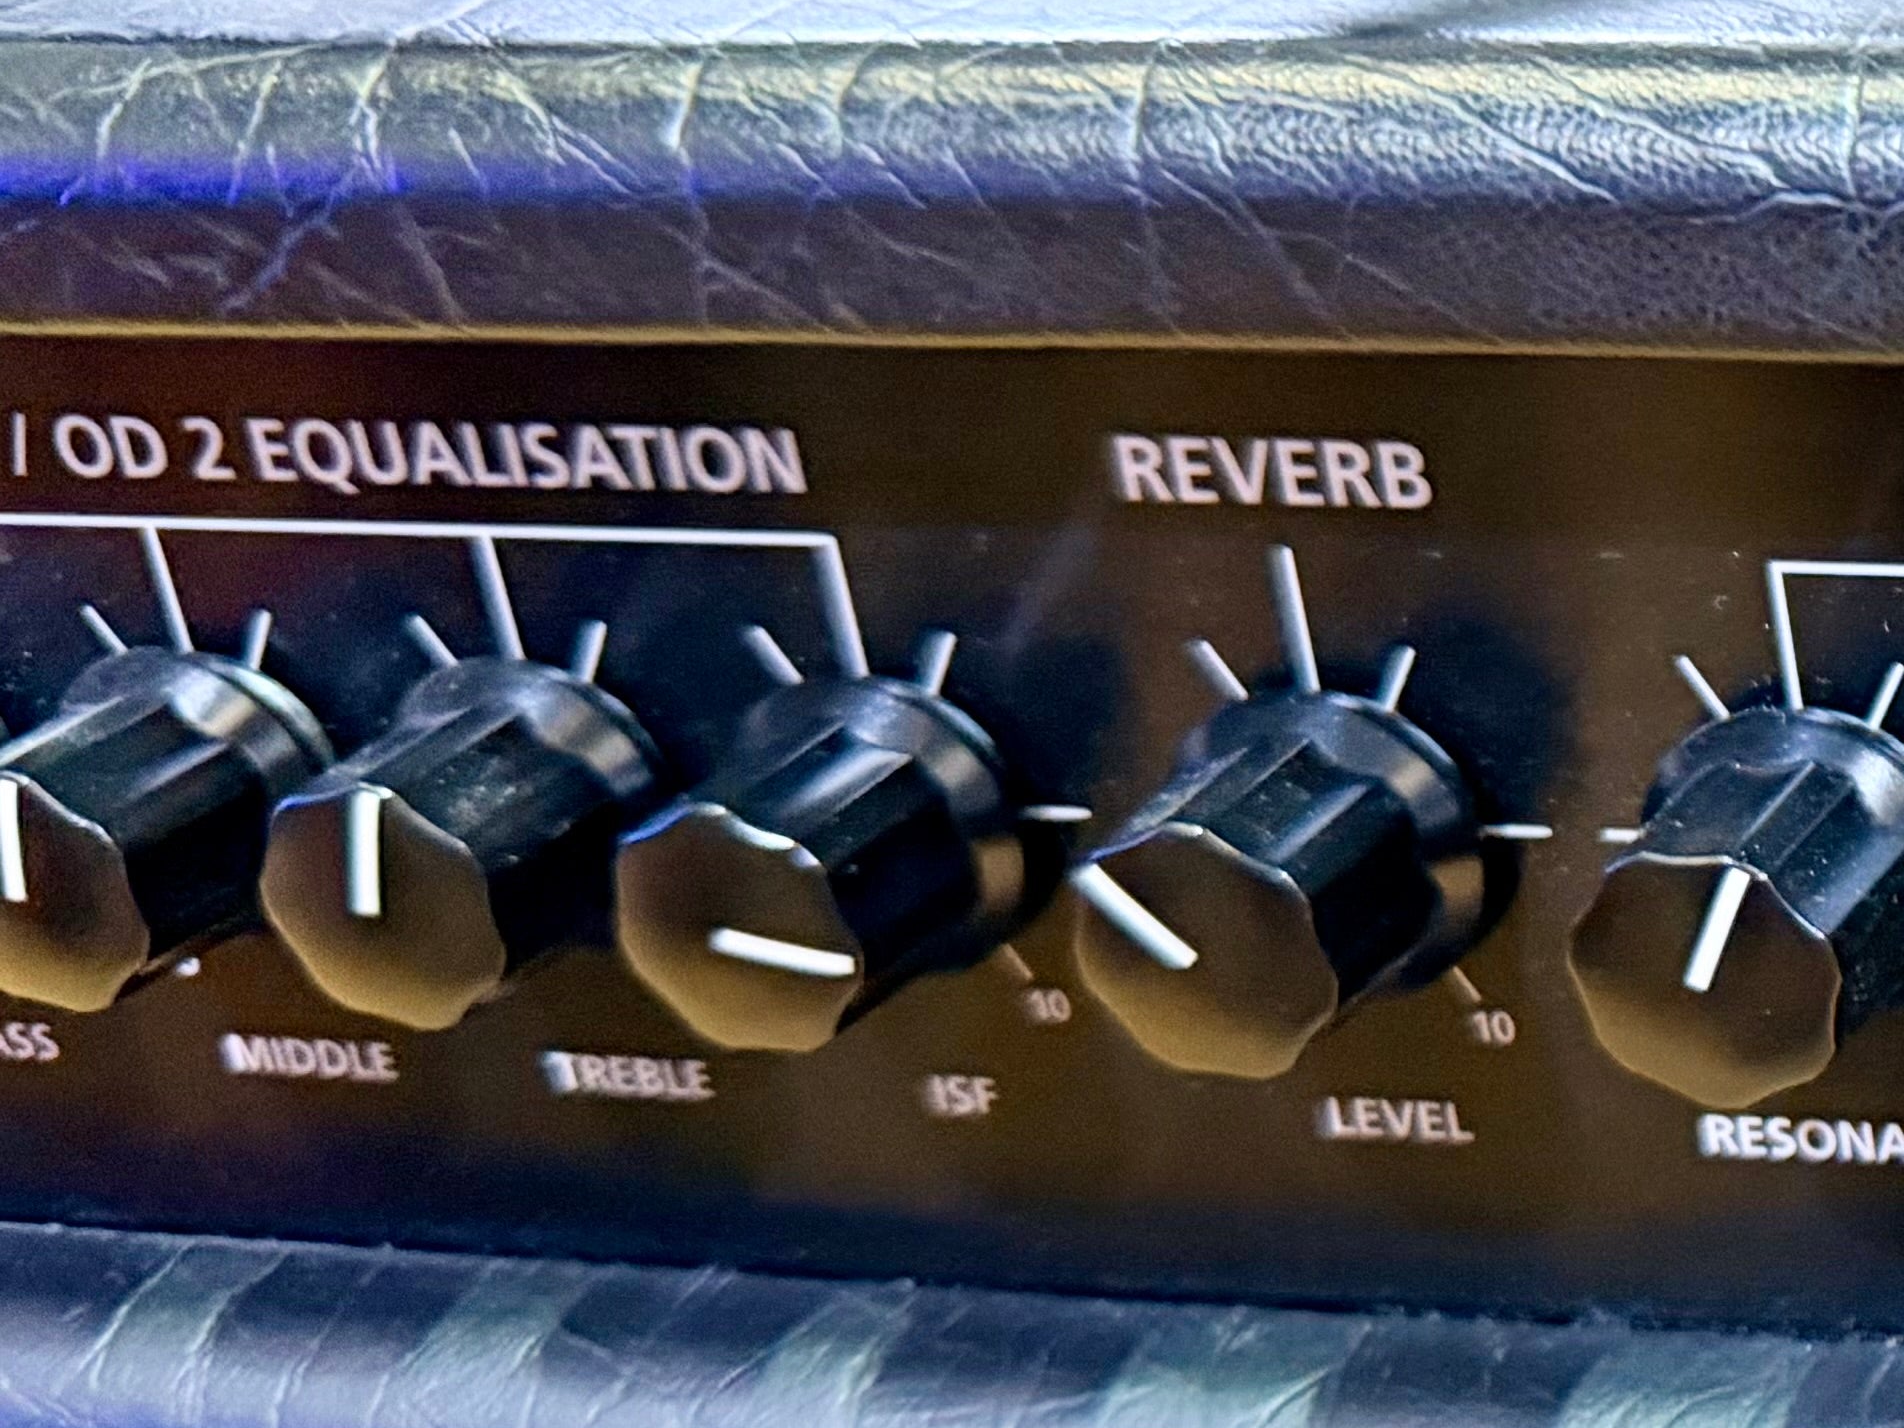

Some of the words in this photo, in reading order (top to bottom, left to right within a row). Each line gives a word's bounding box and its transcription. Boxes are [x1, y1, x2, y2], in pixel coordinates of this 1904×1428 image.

[54, 415, 167, 478] OD
[184, 418, 235, 480] 2
[247, 419, 806, 494] EQUALISATION
[1113, 436, 1431, 508] REVERB
[1027, 990, 1070, 1022] 10
[1473, 1012, 1515, 1043] 10
[222, 1034, 396, 1079] MIDDLE
[544, 1052, 713, 1098] TREBLE
[928, 1076, 996, 1115] ISF
[1325, 1097, 1474, 1142] LEVEL
